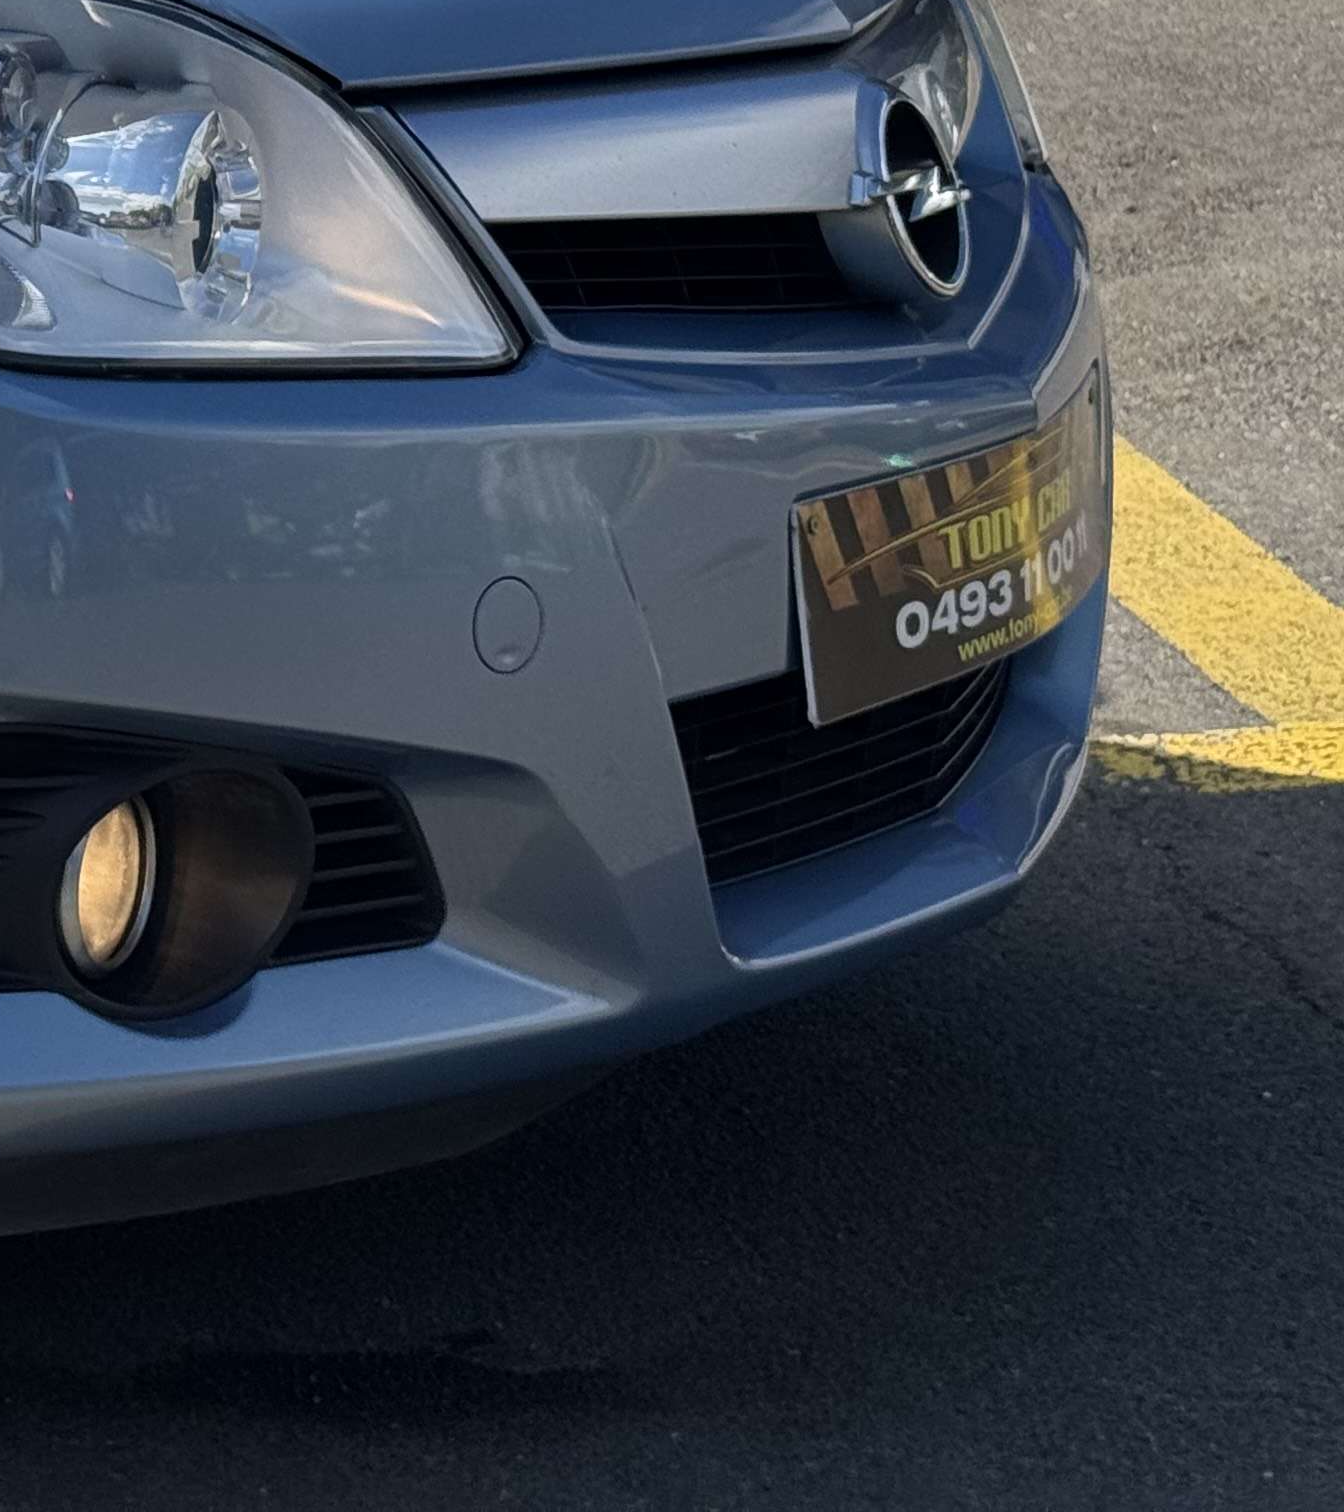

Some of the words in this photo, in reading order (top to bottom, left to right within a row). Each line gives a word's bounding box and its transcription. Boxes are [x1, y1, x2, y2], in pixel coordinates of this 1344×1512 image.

[939, 496, 1030, 569] TONY
[896, 569, 1012, 649] 0493
[1020, 550, 1043, 602] 11
[1047, 527, 1075, 585] 00
